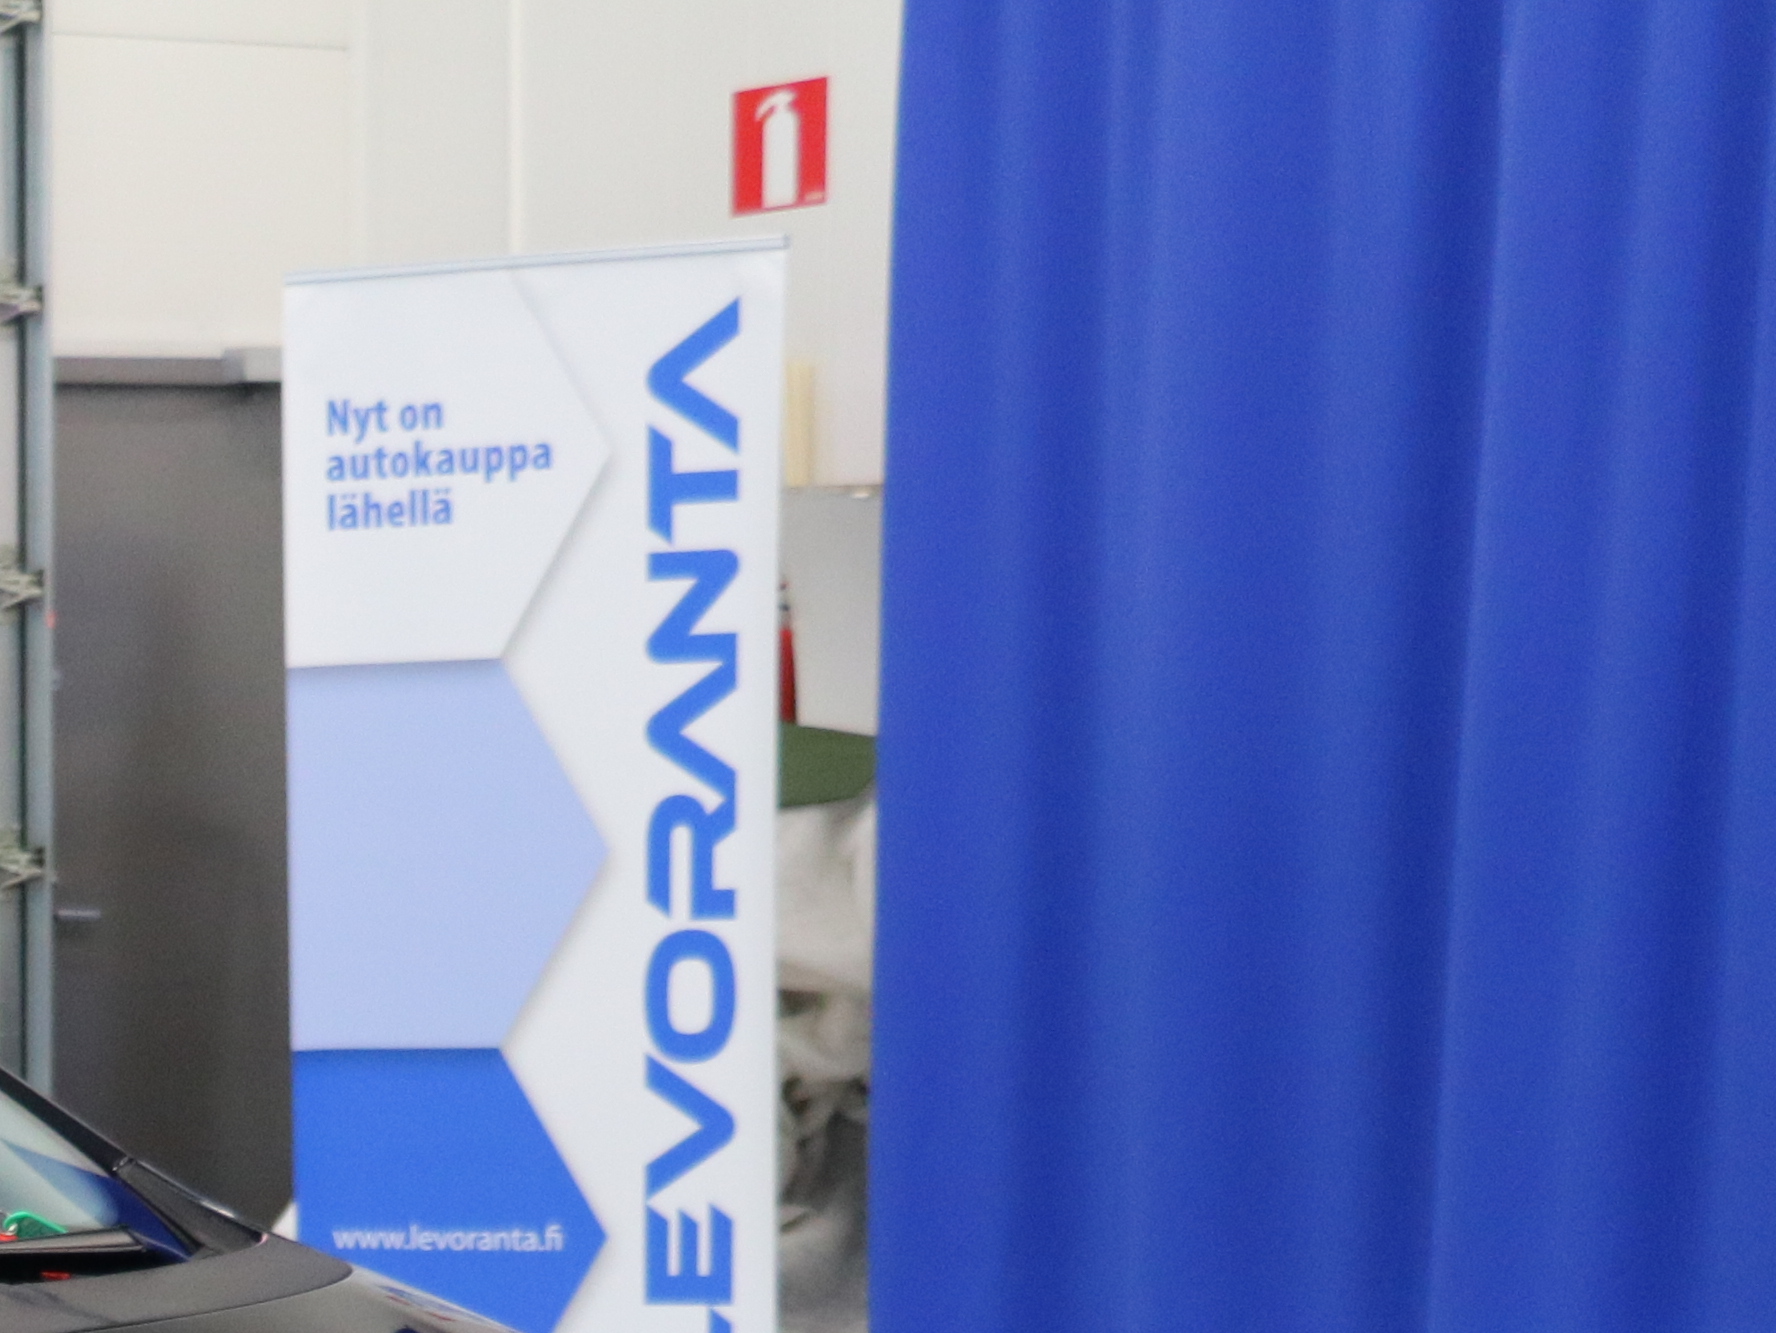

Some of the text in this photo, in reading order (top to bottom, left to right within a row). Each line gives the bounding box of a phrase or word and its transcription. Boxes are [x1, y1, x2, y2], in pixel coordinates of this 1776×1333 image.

[326, 399, 444, 444] Nyt on
[326, 440, 553, 483] autokauppa
[327, 488, 453, 531] lähellä
[332, 1224, 565, 1251] www.levoranta.fi
